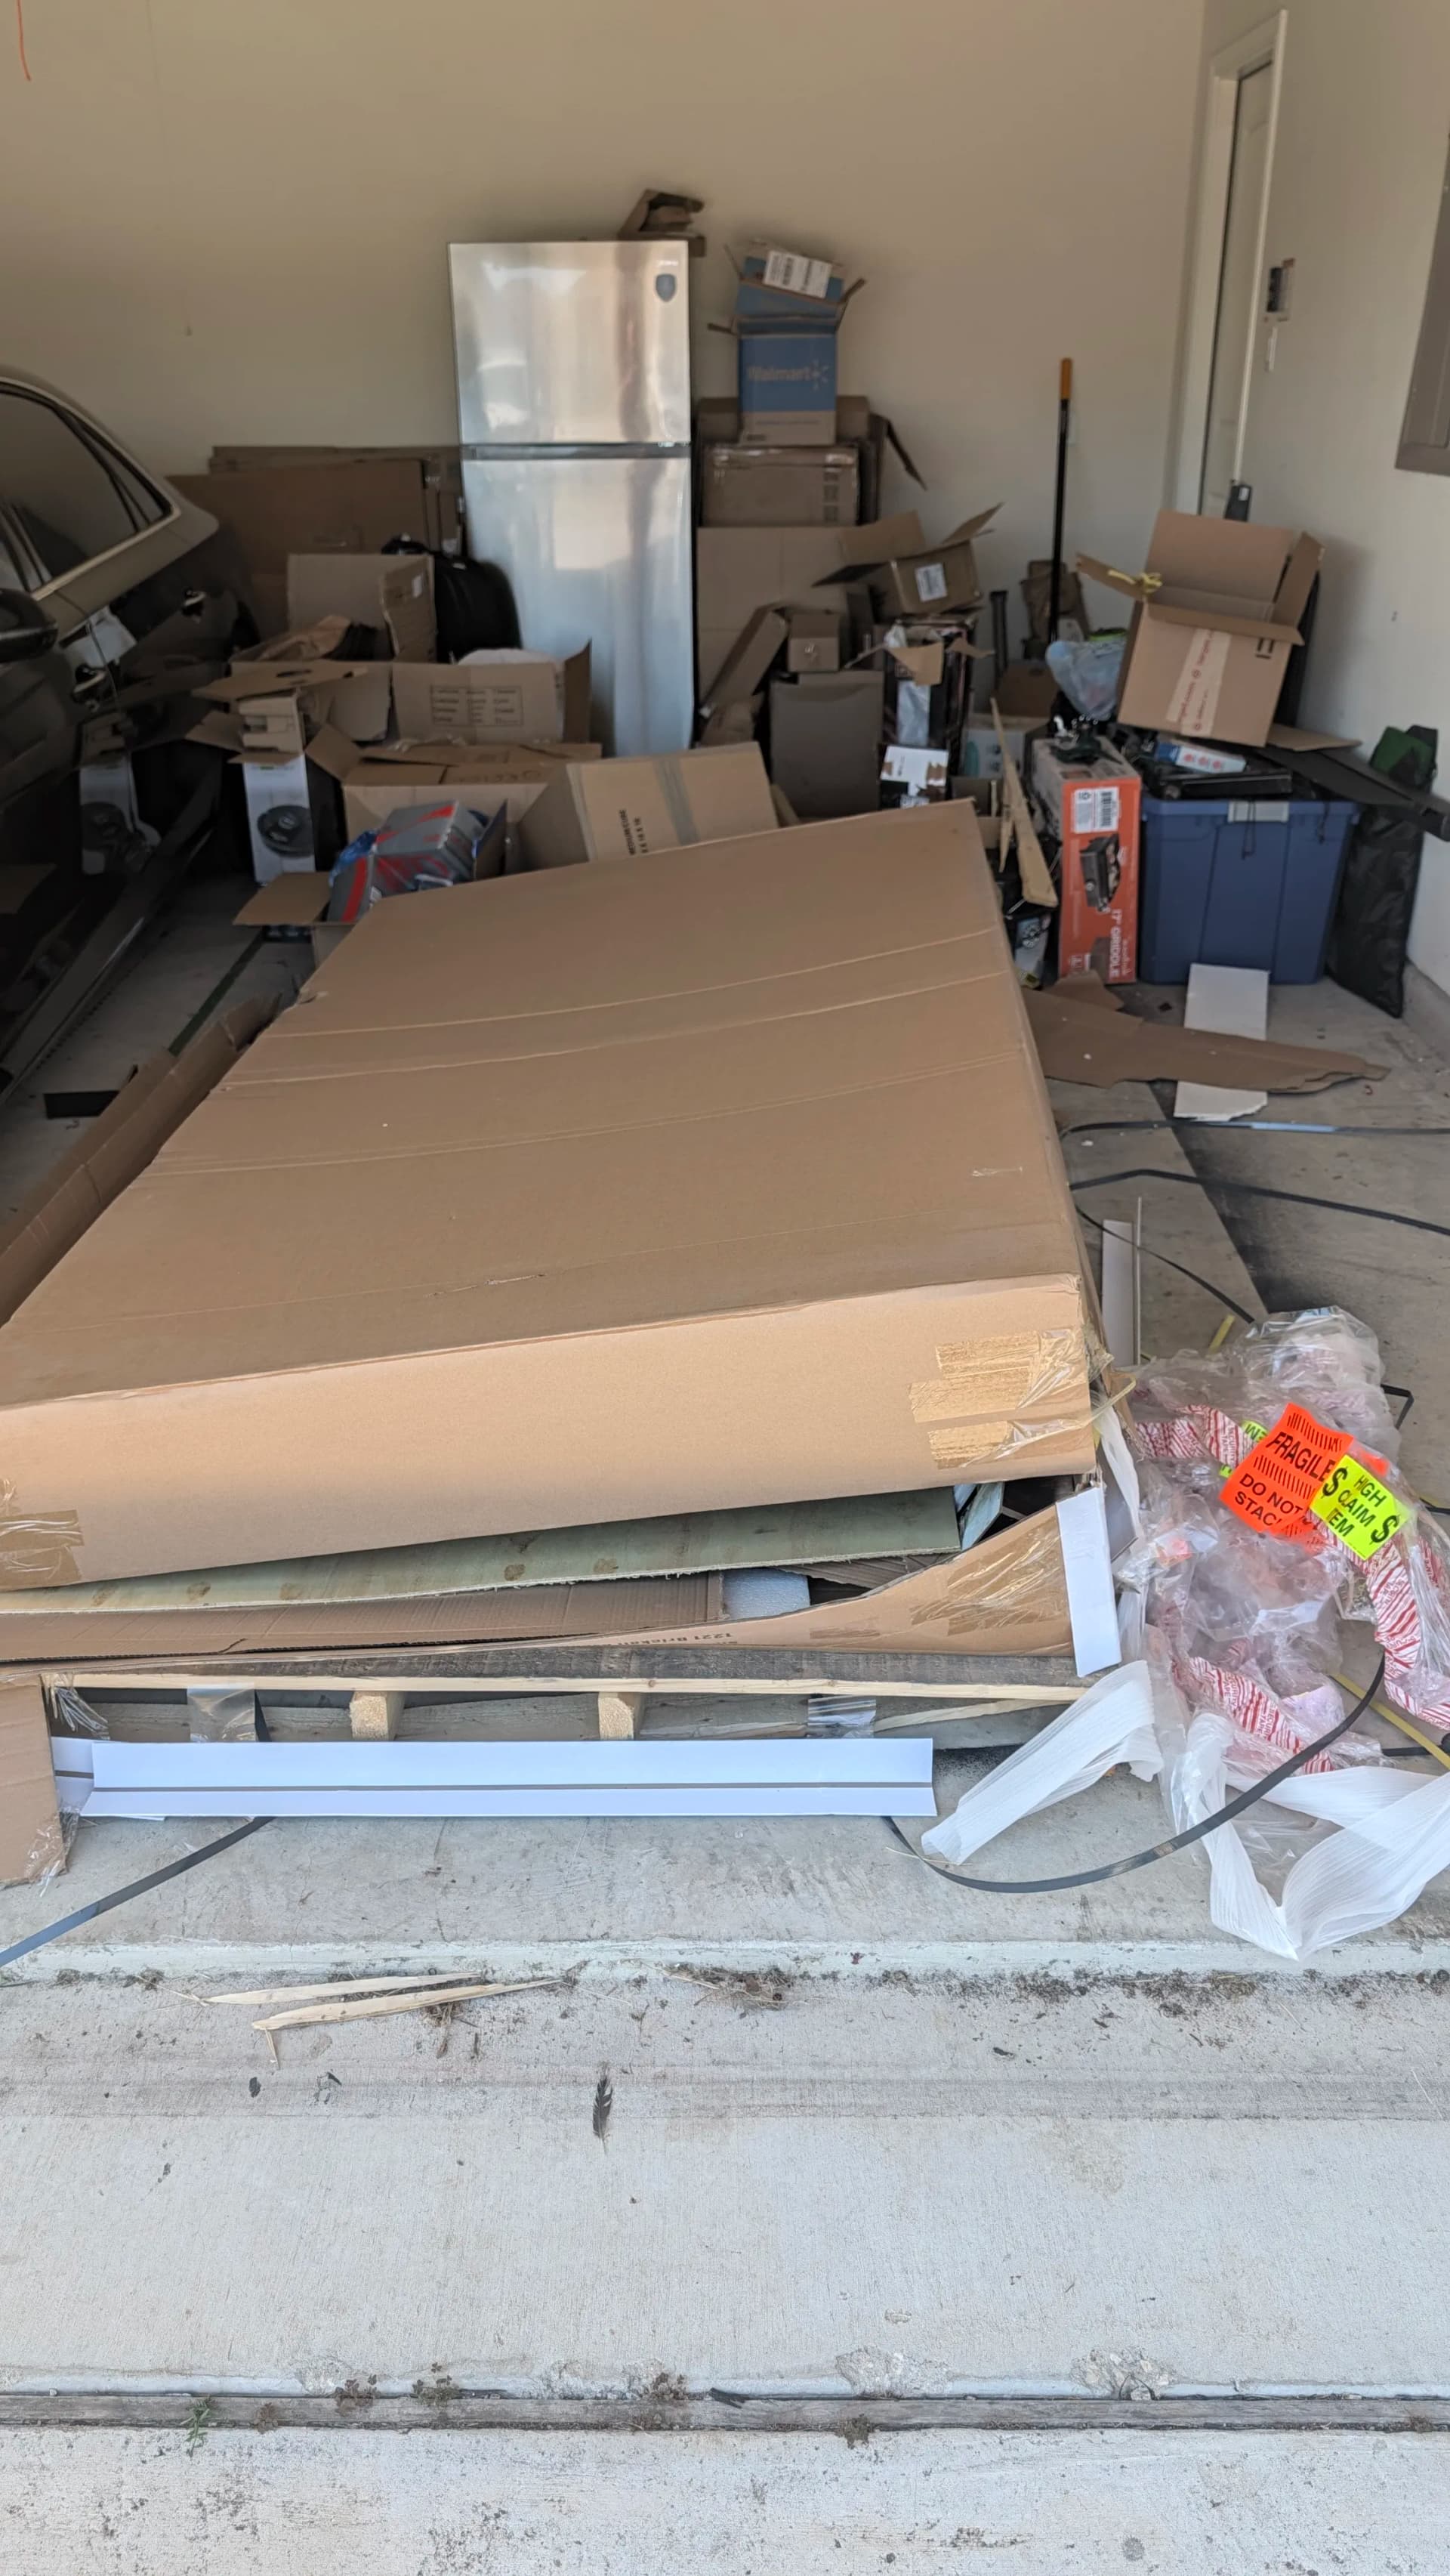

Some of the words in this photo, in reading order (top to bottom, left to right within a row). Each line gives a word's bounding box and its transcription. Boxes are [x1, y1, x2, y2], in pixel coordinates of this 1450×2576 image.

[1109, 927, 1122, 978] GRIDDLE
[1235, 1490, 1282, 1526] STAC
[1239, 1474, 1266, 1496] DO
[1267, 1492, 1303, 1515] NOT
[1337, 1490, 1376, 1527] CLAIM
[1353, 1475, 1387, 1508] HIGH
